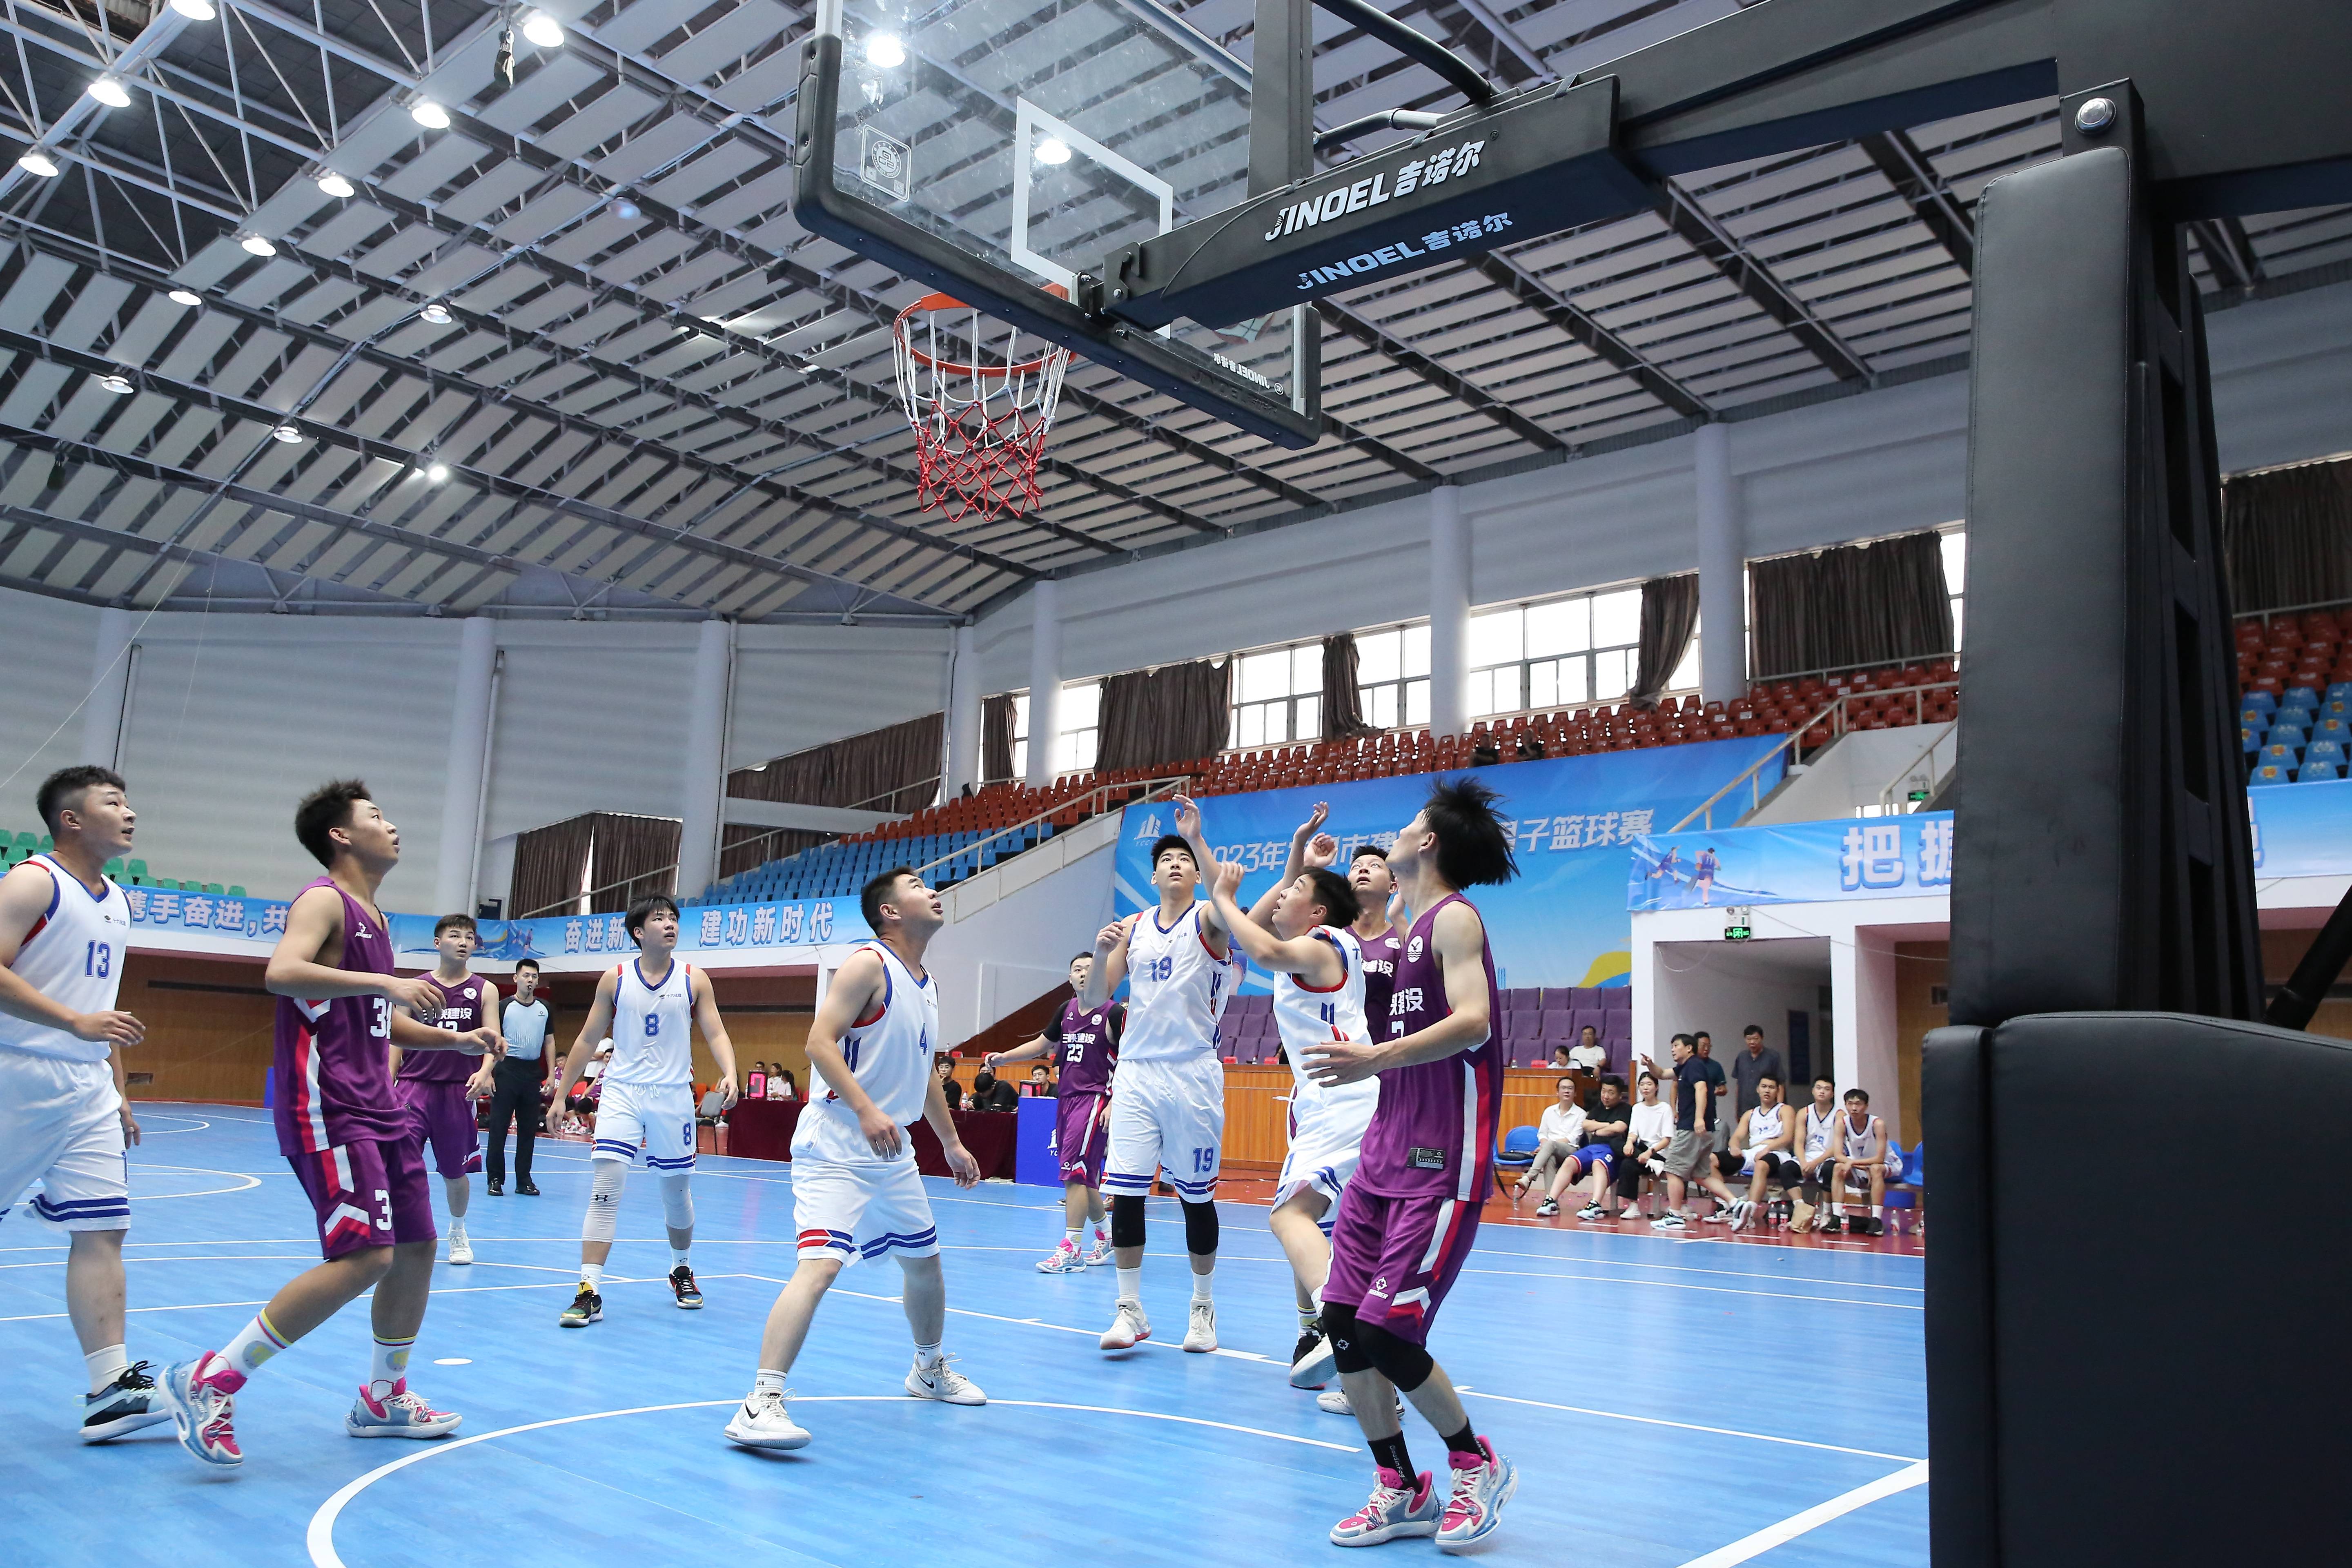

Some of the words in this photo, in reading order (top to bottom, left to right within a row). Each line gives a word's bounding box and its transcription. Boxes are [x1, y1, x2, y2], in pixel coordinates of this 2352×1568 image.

[1265, 173, 1390, 241] JINOEL
[1394, 140, 1486, 197] 吉诺尔
[1297, 241, 1425, 289] JINOEL
[1421, 212, 1513, 251] 吉诺尔
[565, 916, 640, 953] 奋进新
[700, 902, 834, 947] 建功新时代
[85, 940, 111, 979] 13
[1149, 956, 1173, 982] 19
[645, 1013, 659, 1037] 8
[919, 1022, 928, 1055] 4
[1062, 1033, 1096, 1045] 三峡建设
[1067, 1043, 1084, 1062] 23
[682, 1122, 691, 1147] 8
[1193, 1146, 1214, 1173] 19
